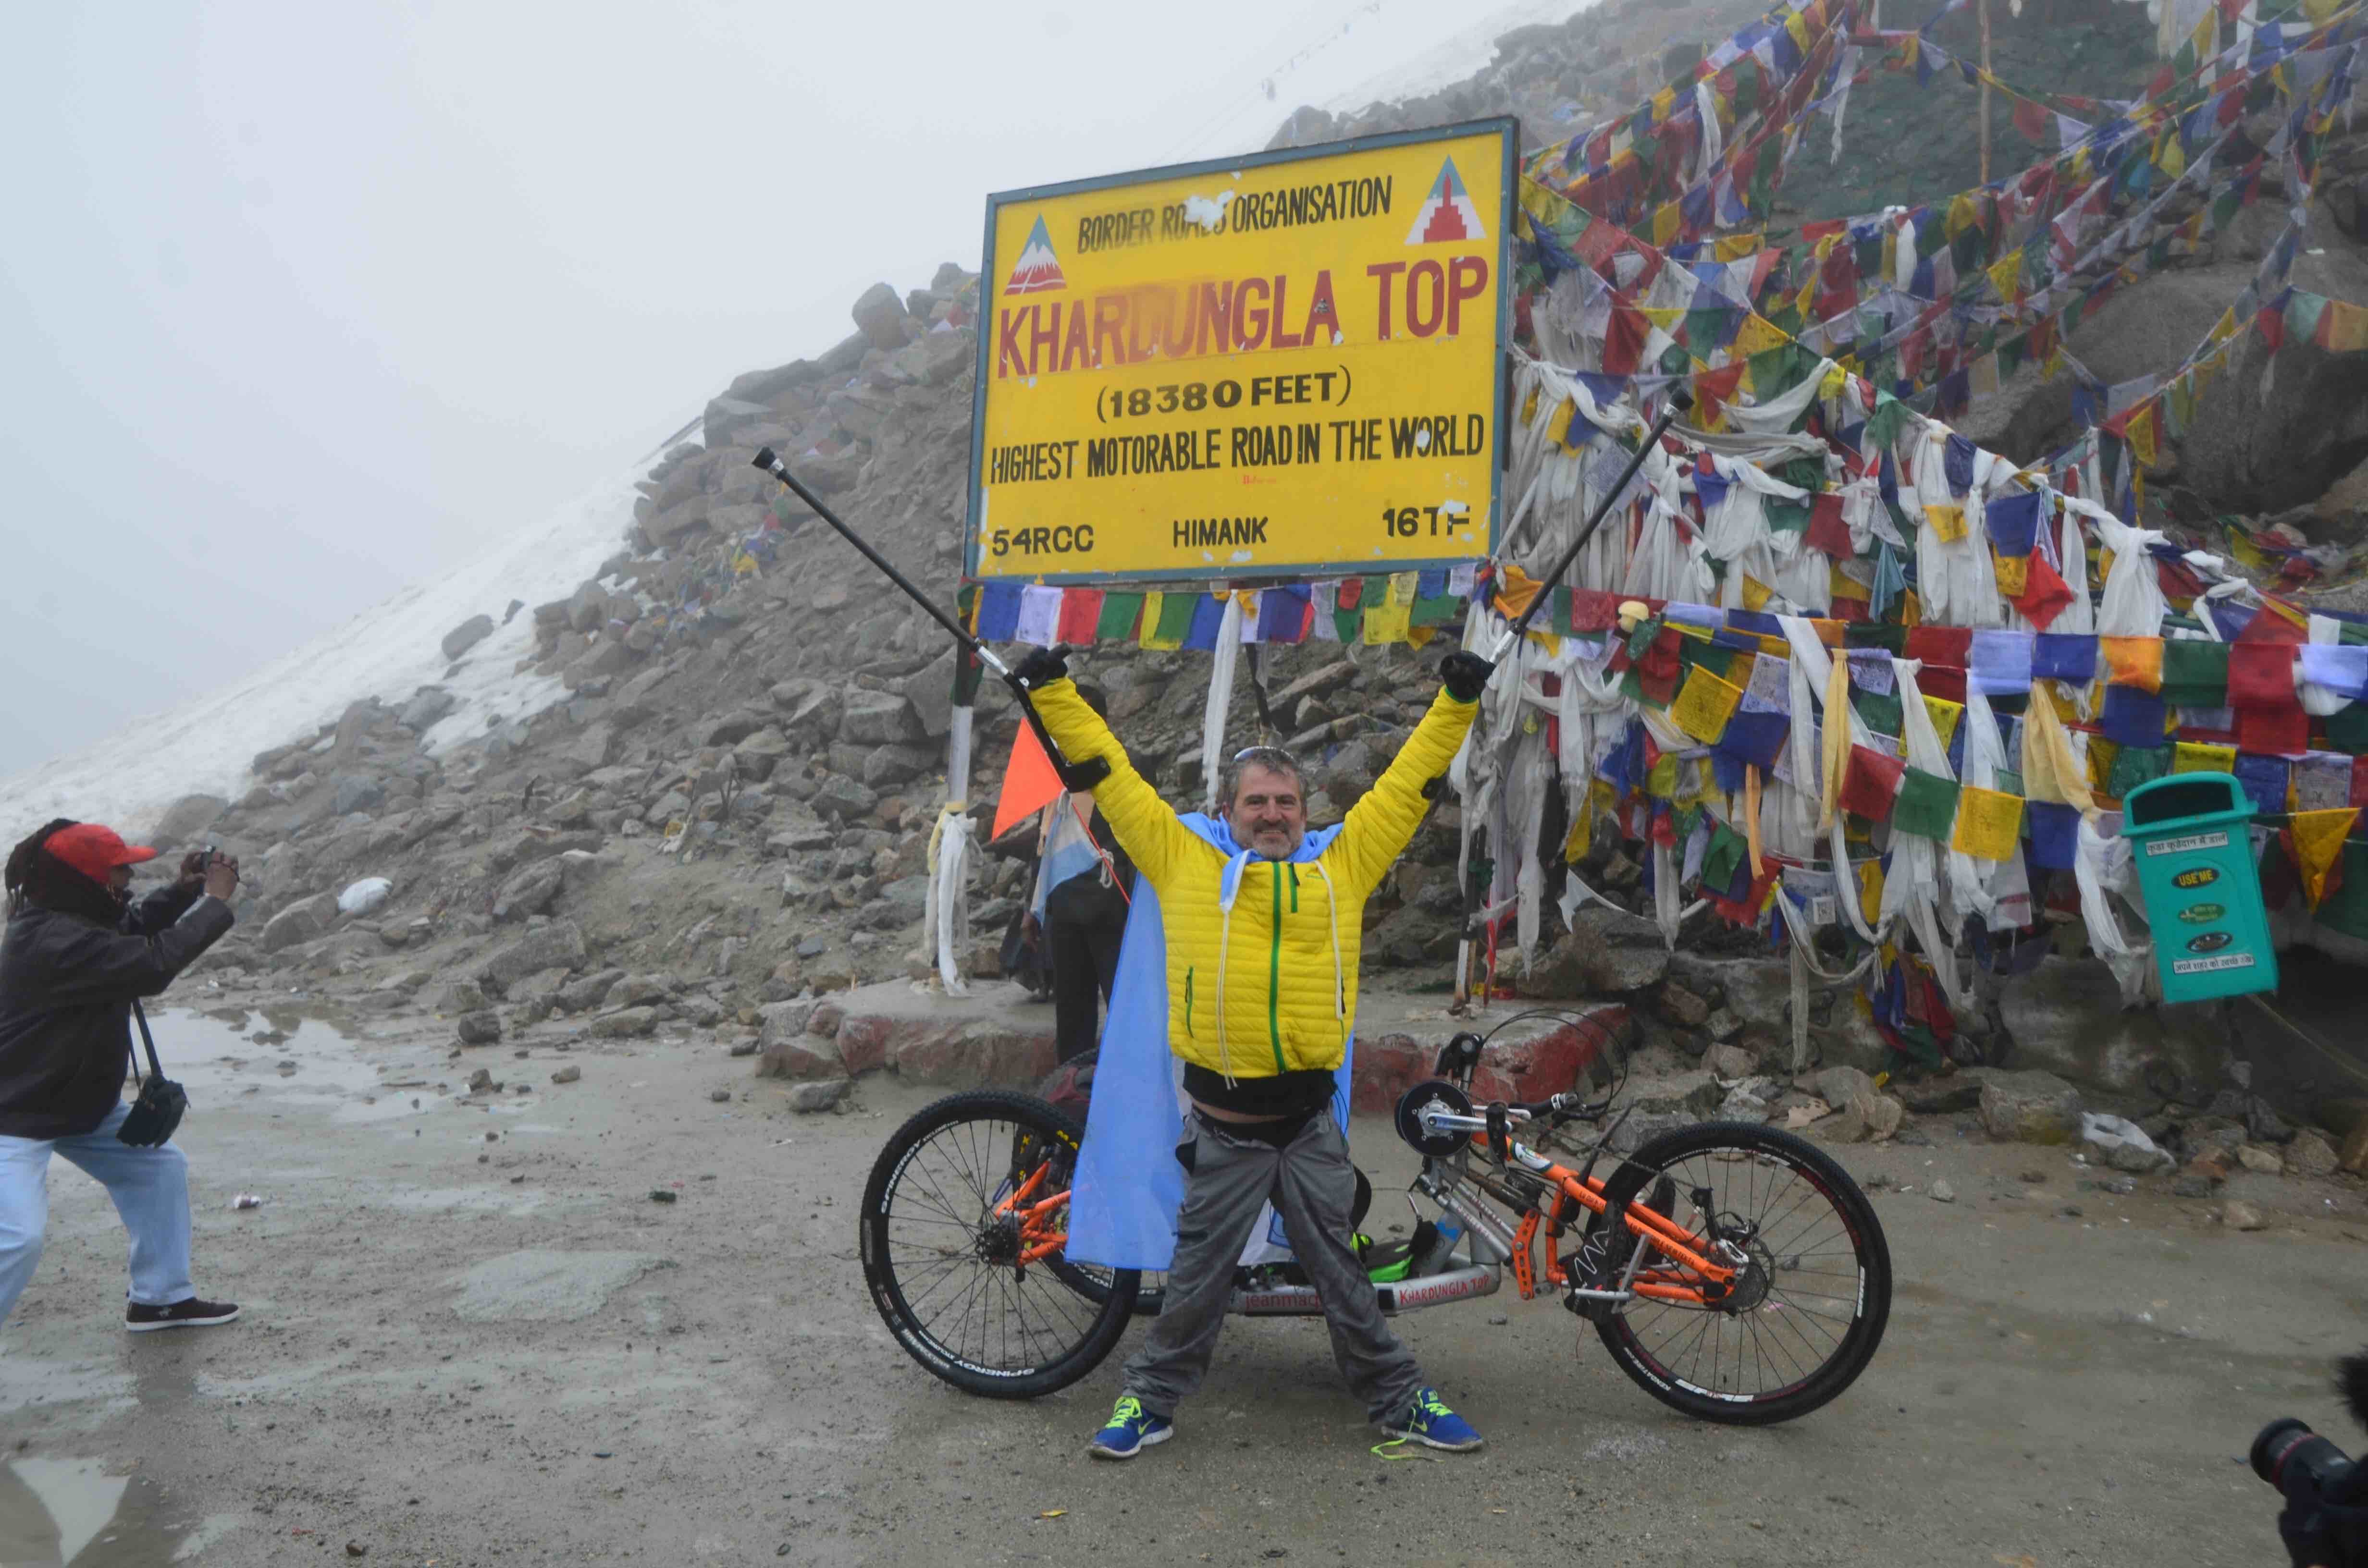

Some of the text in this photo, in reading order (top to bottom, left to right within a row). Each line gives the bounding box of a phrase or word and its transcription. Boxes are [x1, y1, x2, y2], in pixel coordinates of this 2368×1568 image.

[1077, 175, 1393, 254] BORDER ROS ORGANISATION
[998, 255, 1489, 379] KHARDUNGLA TOP
[1096, 365, 1351, 423] (18380 FEET)
[991, 414, 1484, 484] HIGHEST MOTORABLE ROAD IN THE WORLD
[992, 505, 1470, 556] 54RCC HIMANK 16TF
[2179, 869, 2214, 886] USE ME
[881, 1139, 921, 1213] SPINERGY
[1399, 1274, 1489, 1306] KHARDUNGLA TOP
[954, 1360, 1034, 1377] SPINERGY
